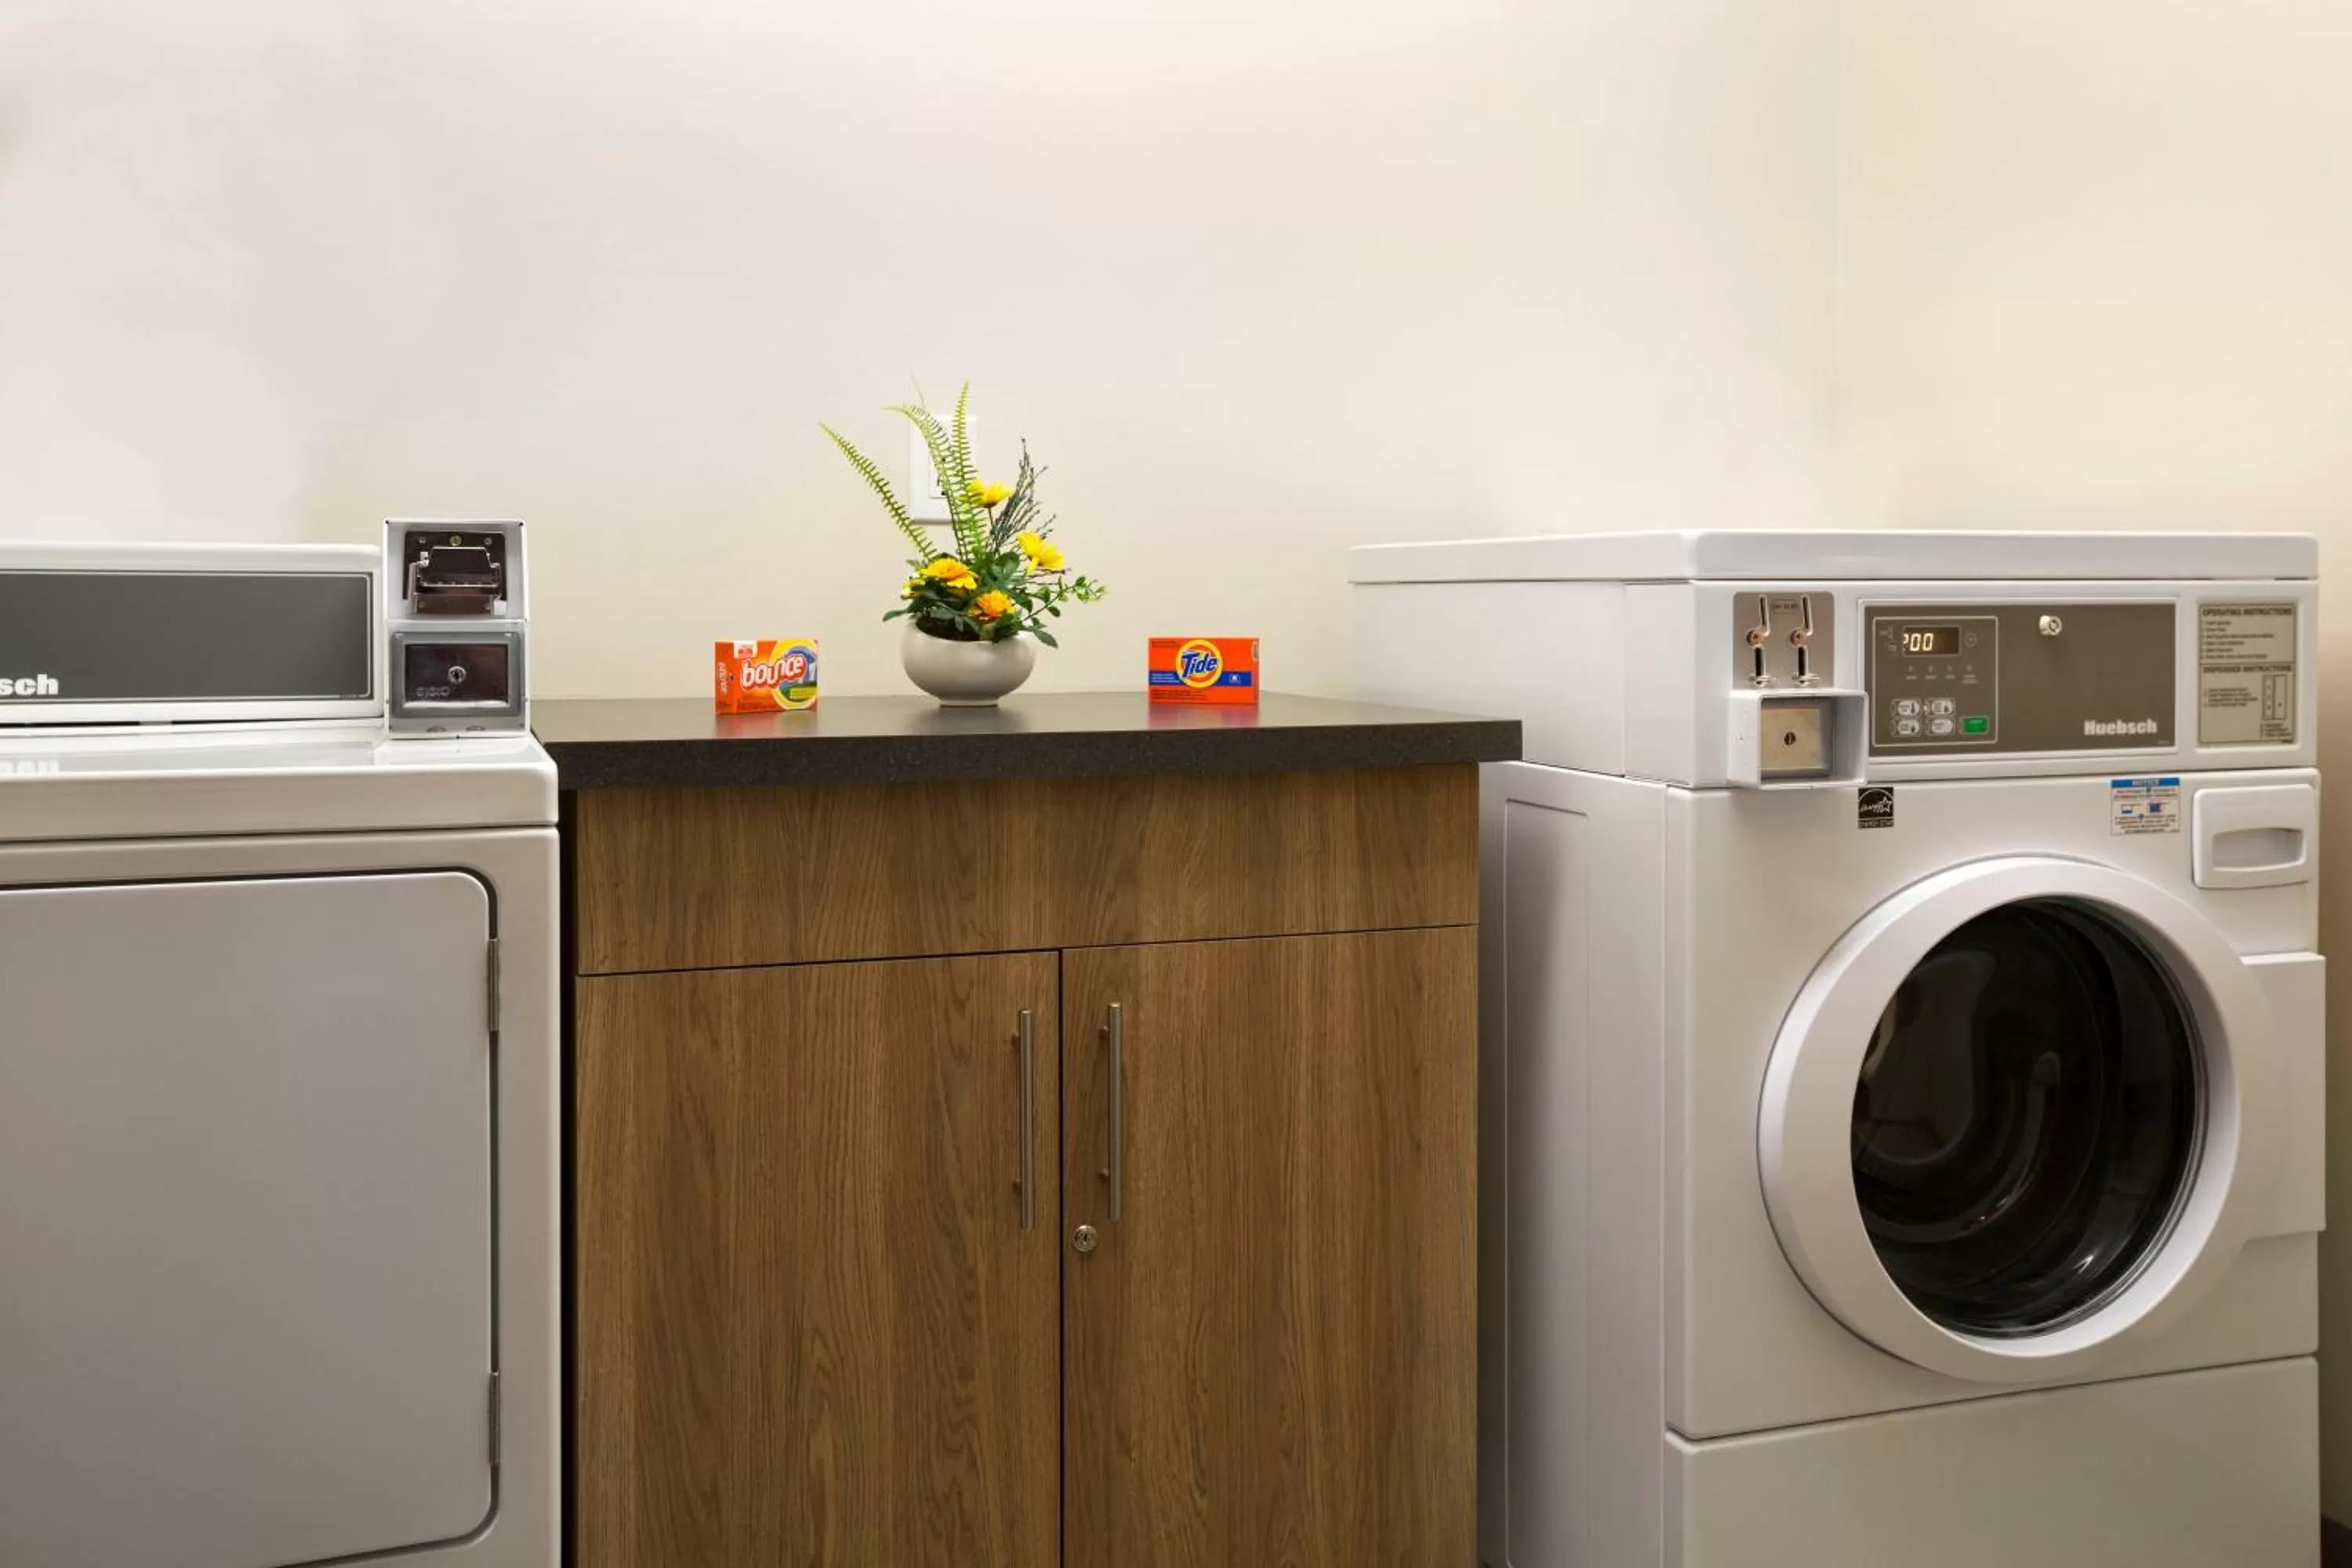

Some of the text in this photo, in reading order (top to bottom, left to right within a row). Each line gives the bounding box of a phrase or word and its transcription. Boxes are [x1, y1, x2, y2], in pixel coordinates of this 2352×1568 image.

[742, 654, 805, 688] bounce
[1181, 652, 1218, 679] Tide
[0, 673, 59, 696] sch
[2084, 717, 2158, 735] Huebsch
